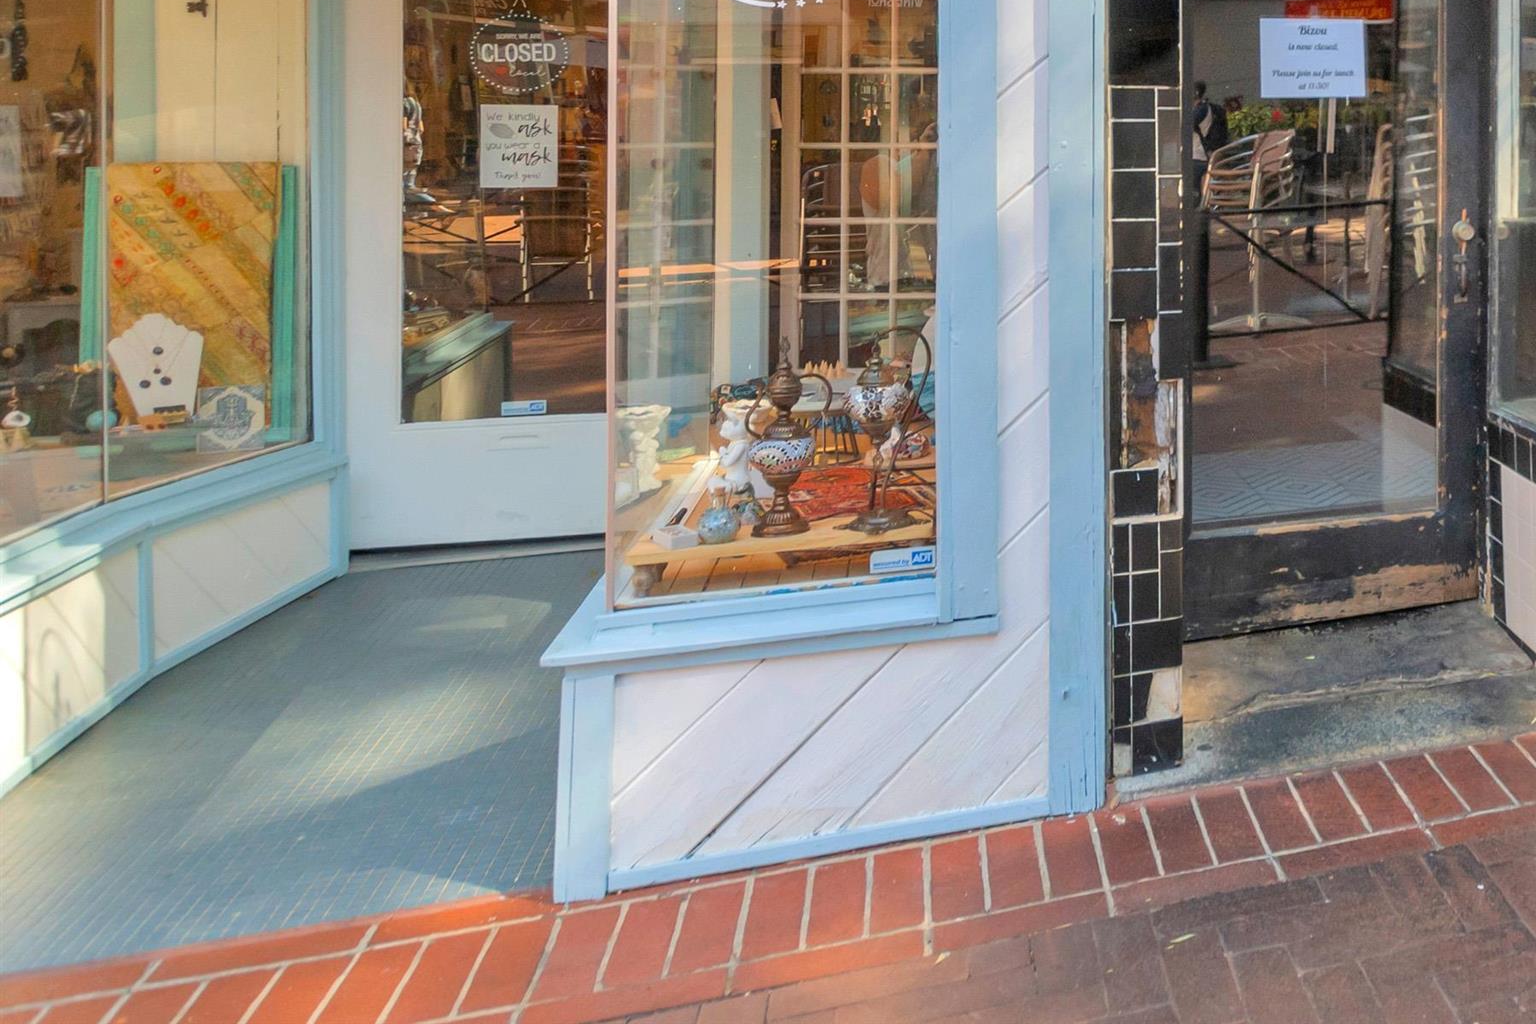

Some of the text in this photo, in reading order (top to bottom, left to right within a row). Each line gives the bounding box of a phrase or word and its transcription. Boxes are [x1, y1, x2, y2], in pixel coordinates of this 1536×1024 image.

[1298, 25, 1327, 36] Bizou
[481, 43, 556, 63] CLOSED
[1296, 70, 1312, 79] join
[487, 111, 541, 123] We kindly
[518, 118, 553, 137] ask
[486, 142, 502, 151] you
[501, 147, 552, 166] mask
[912, 551, 932, 564] ADT
